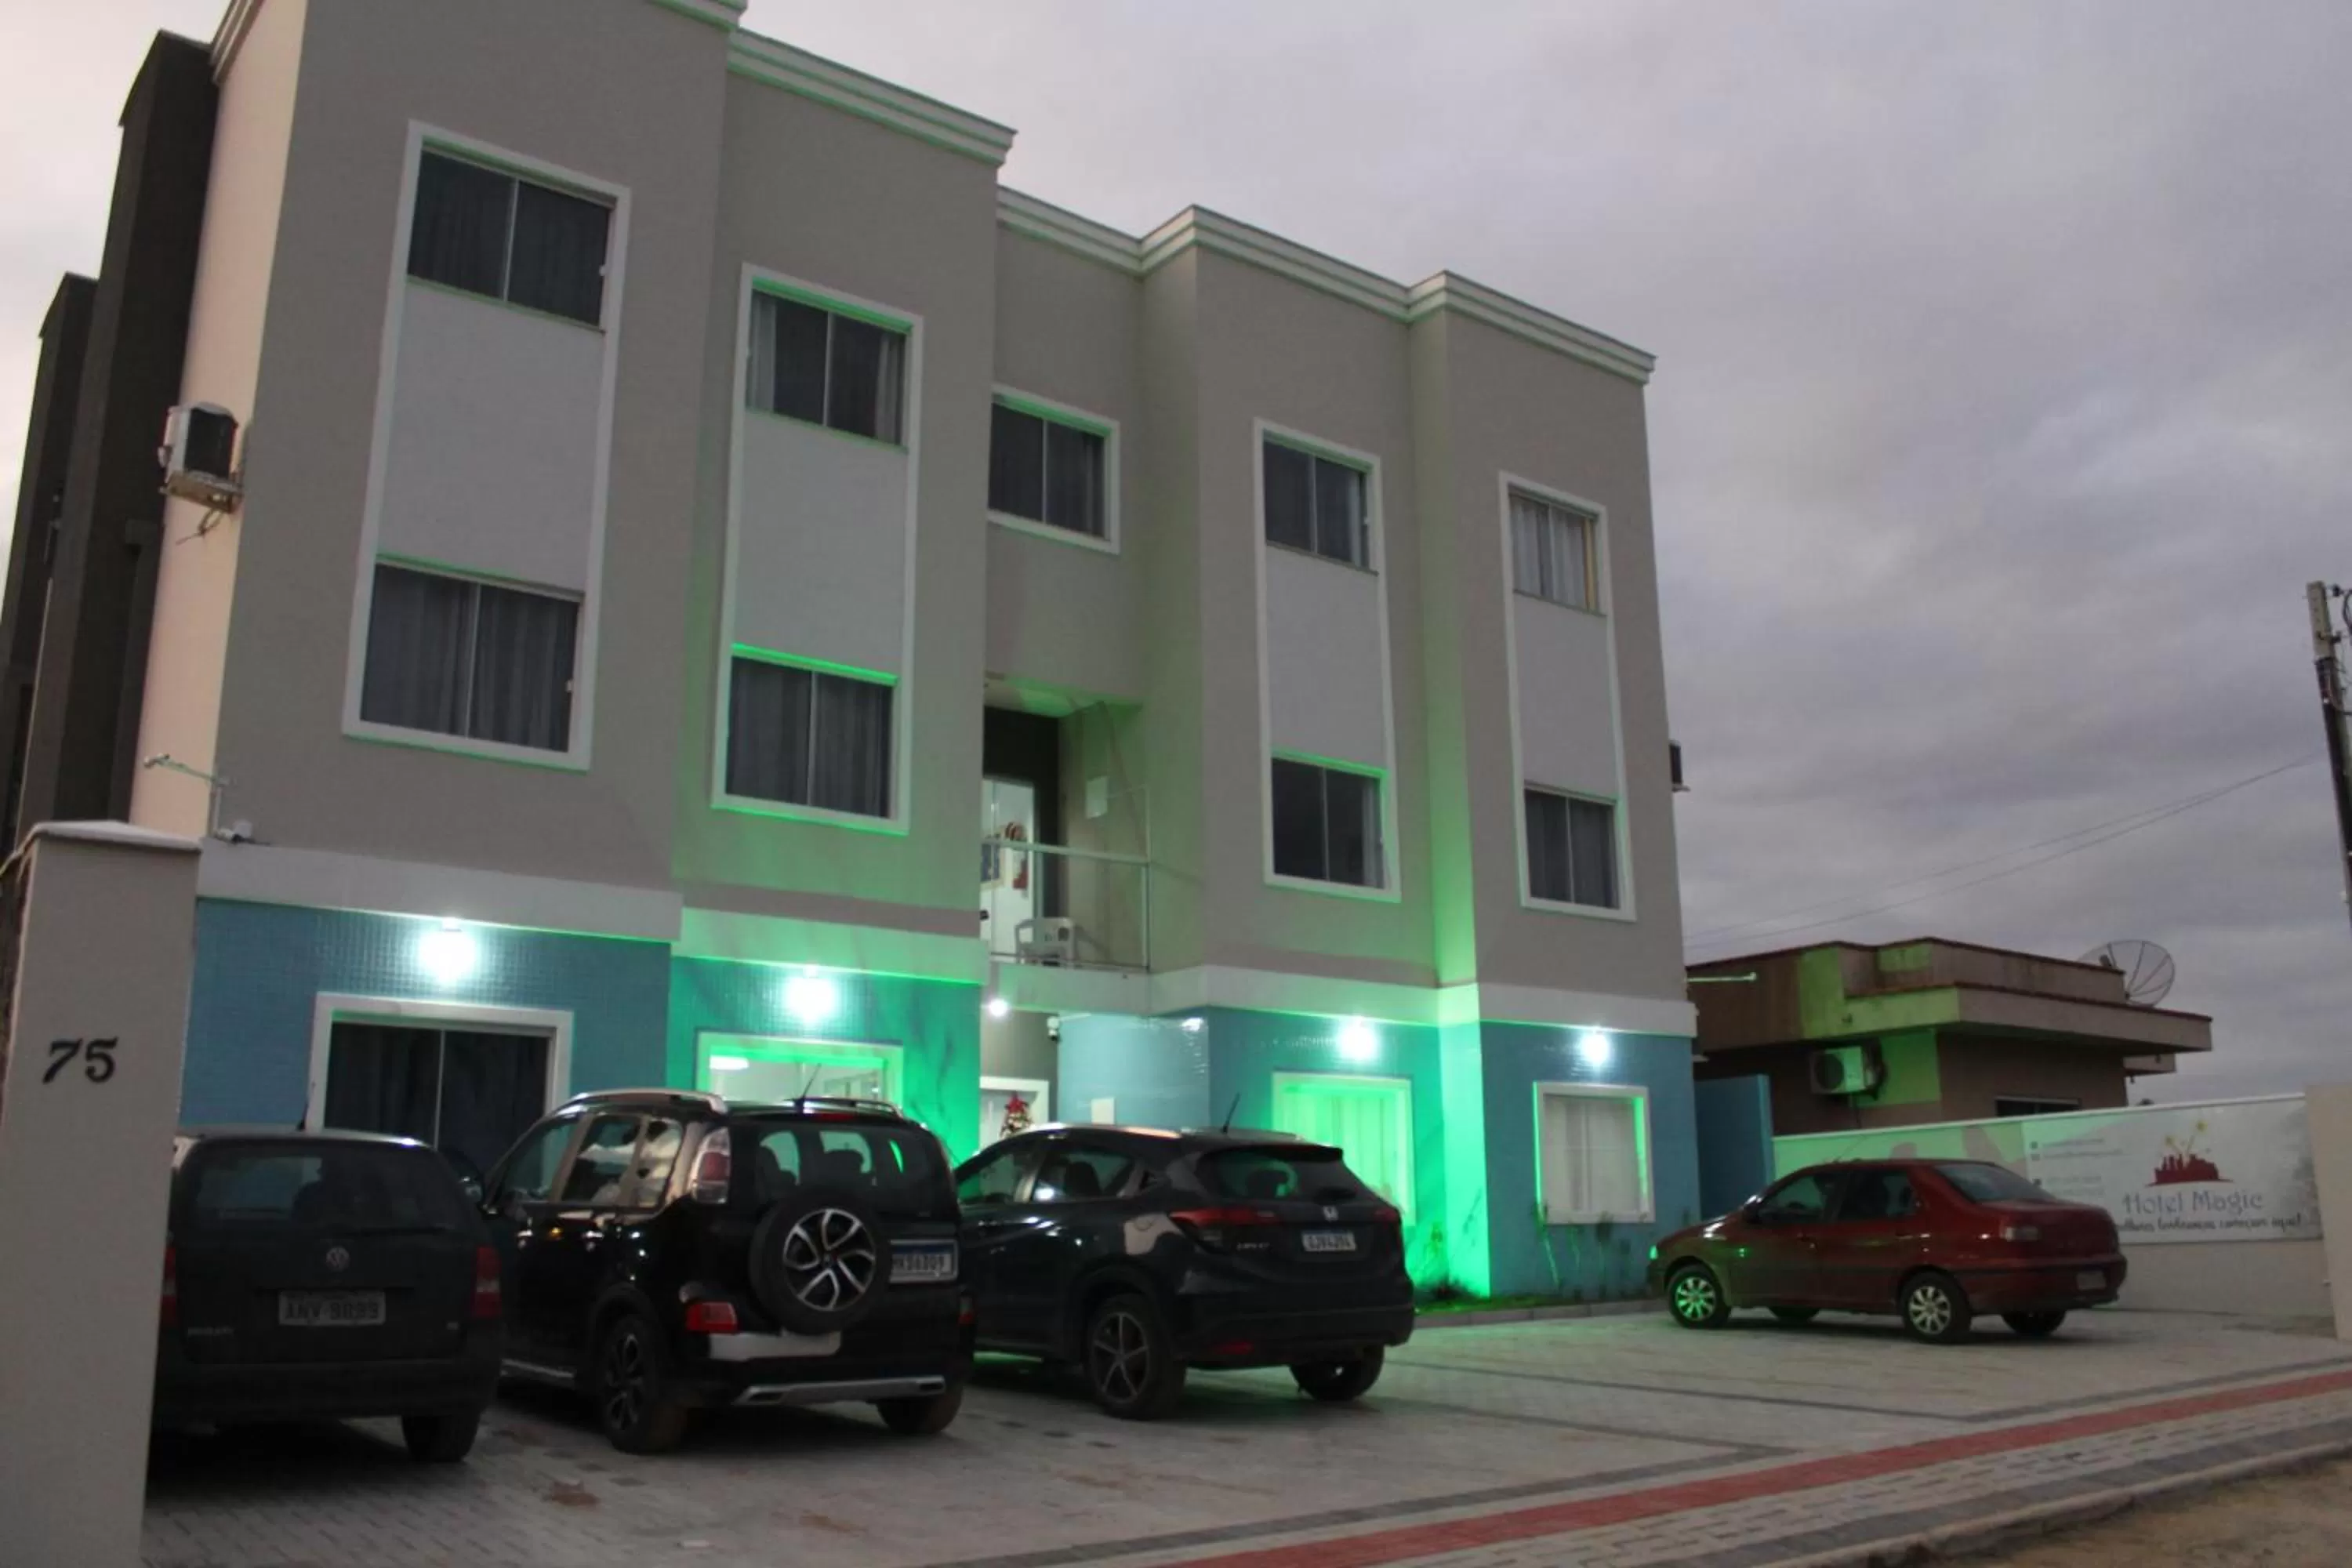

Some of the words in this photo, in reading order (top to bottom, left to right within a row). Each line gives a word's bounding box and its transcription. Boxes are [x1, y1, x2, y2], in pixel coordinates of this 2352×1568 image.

[42, 1036, 118, 1085] 75
[2122, 1192, 2183, 1214] Hotel
[2193, 1189, 2263, 1215] Magic
